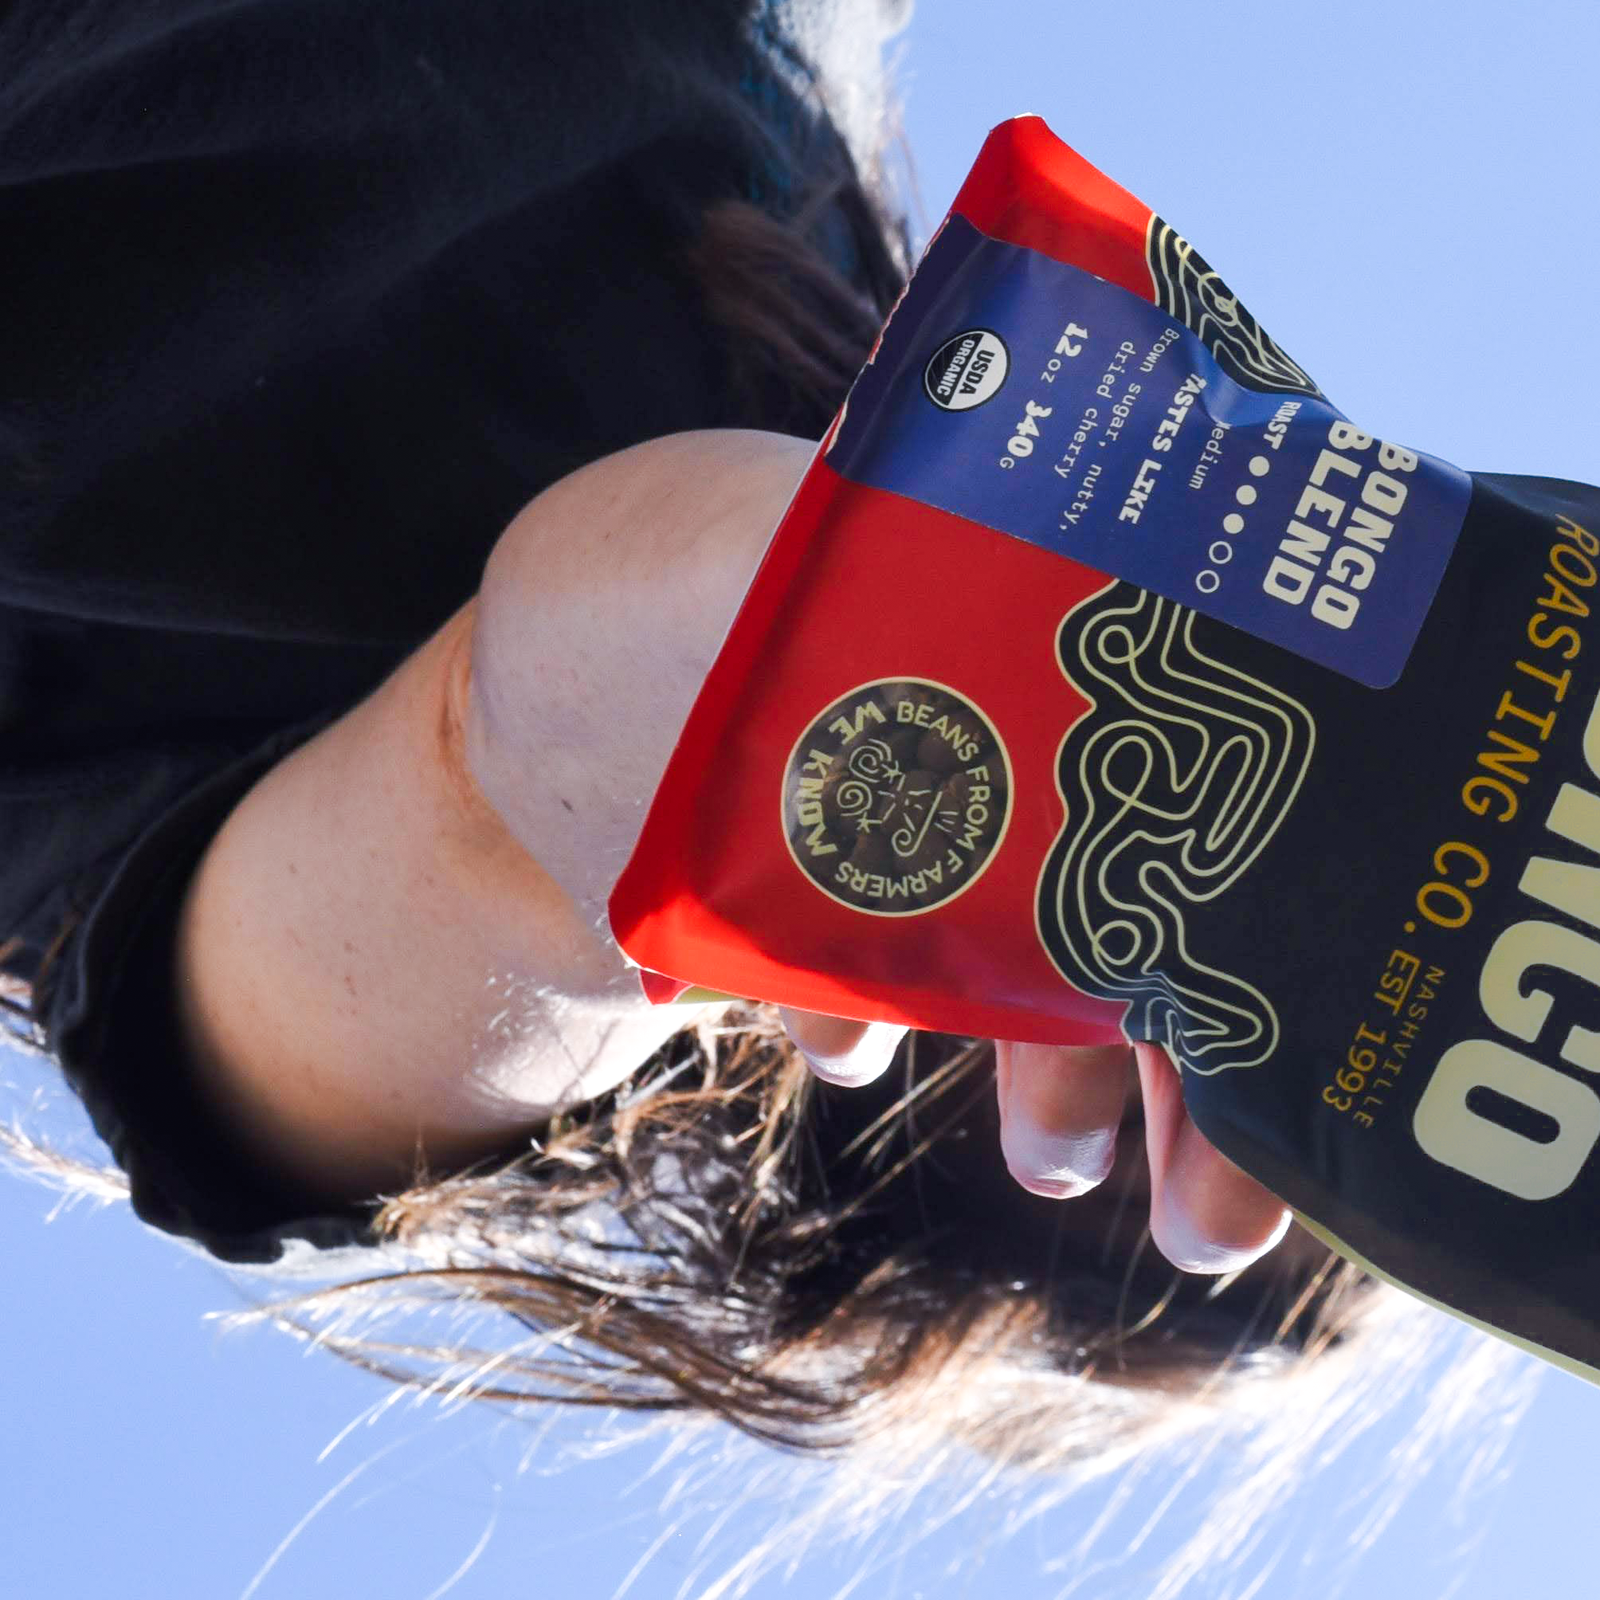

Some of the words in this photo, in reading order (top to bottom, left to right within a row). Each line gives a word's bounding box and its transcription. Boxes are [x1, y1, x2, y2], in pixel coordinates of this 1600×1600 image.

[937, 339, 975, 396] ORGANIC
[959, 349, 996, 395] USDA
[1096, 341, 1136, 399] dried
[1139, 327, 1180, 373] Brown
[1054, 408, 1098, 479] cherry
[1099, 382, 1142, 447] sugar,
[1152, 373, 1207, 452] TASTES
[1263, 400, 1302, 450] ROAST
[1059, 464, 1102, 531] nutty,
[1118, 458, 1163, 525] LIKE
[1262, 420, 1374, 606] BLEND
[1310, 441, 1419, 630] BONGO
[1461, 513, 1600, 823] ROASTING
[829, 701, 887, 746] WE
[896, 701, 980, 762] BEANS
[797, 748, 838, 856] KNOW
[955, 765, 991, 851] FROM
[835, 848, 964, 898] FARMERS
[1403, 840, 1490, 934] CO.
[1374, 949, 1421, 1016] EST
[1322, 1022, 1387, 1112] 1993
[1353, 965, 1446, 1129] NASHVILLE
